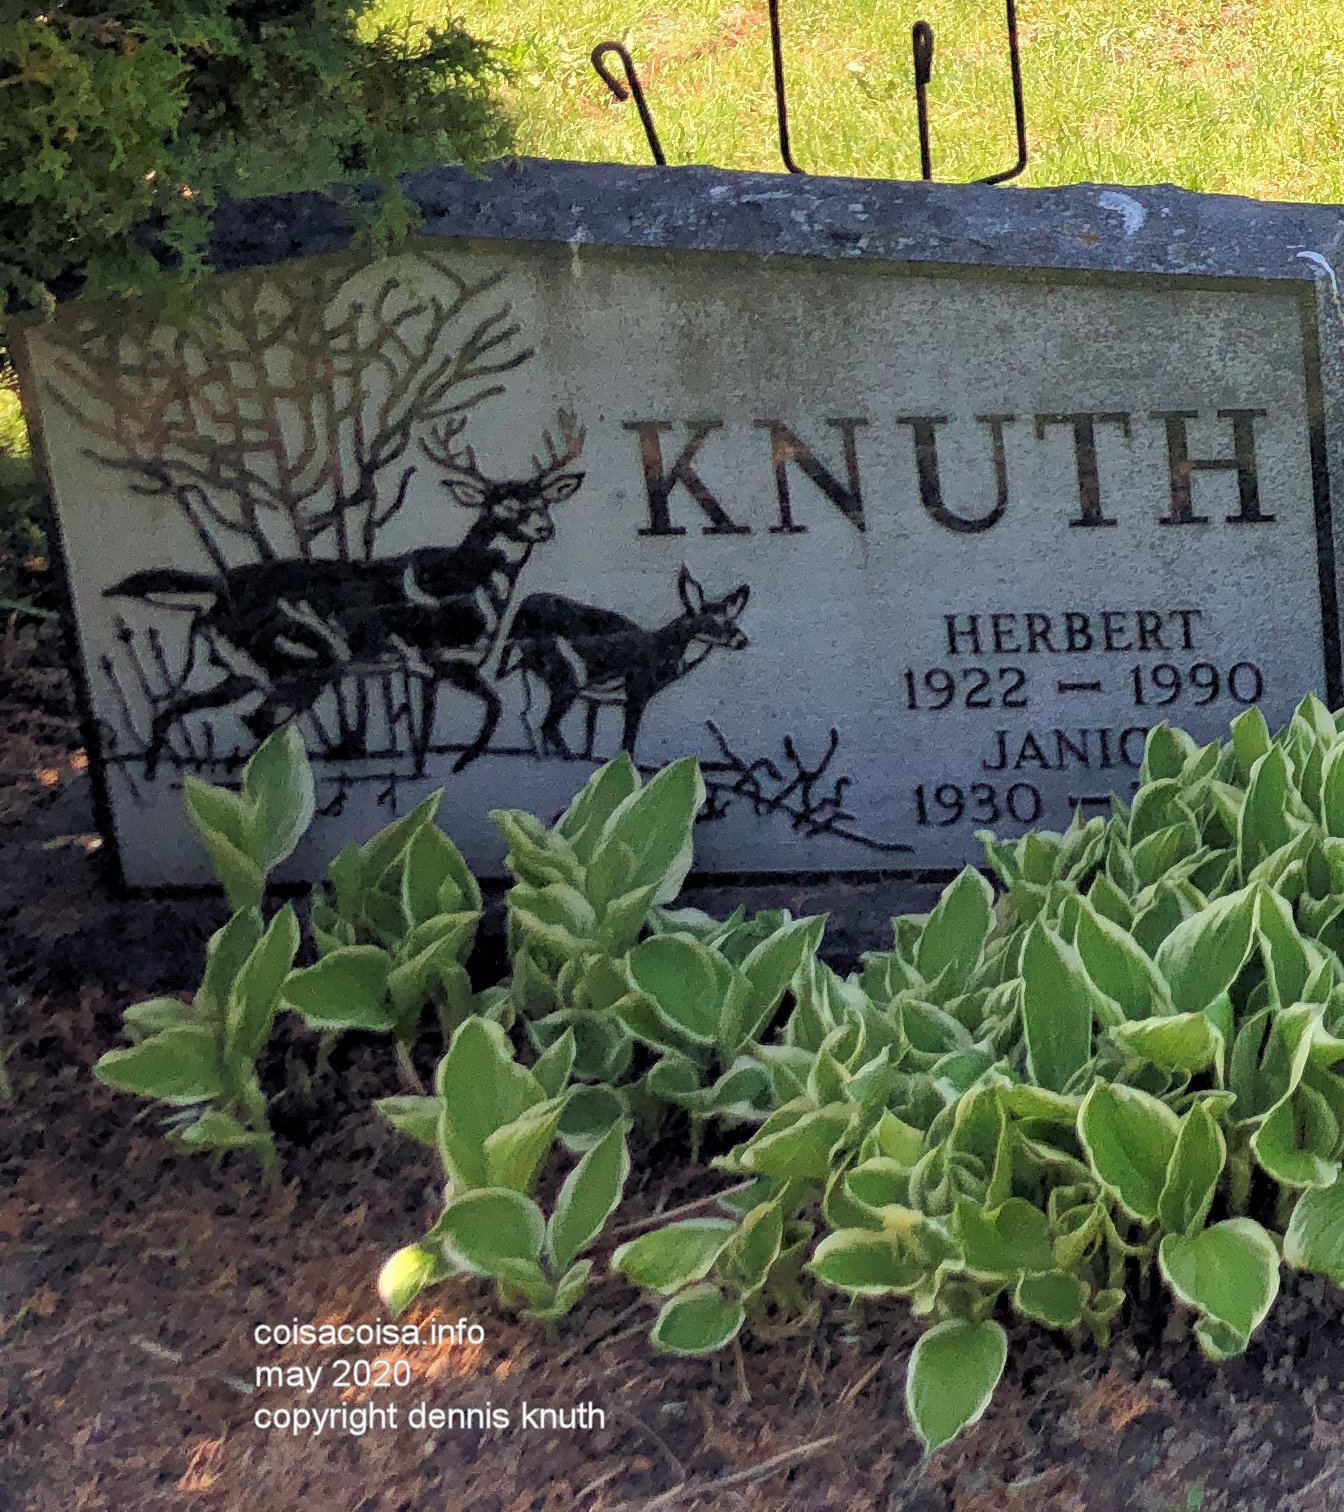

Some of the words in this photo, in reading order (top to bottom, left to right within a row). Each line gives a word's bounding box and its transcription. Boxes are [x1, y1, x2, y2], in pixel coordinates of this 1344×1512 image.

[621, 408, 1276, 537] KNUTH
[943, 609, 1202, 656] HERBERT
[904, 666, 1028, 711] 1922
[1130, 661, 1264, 706] 1990
[983, 725, 1149, 770] JANIC
[915, 782, 1042, 827] 1930
